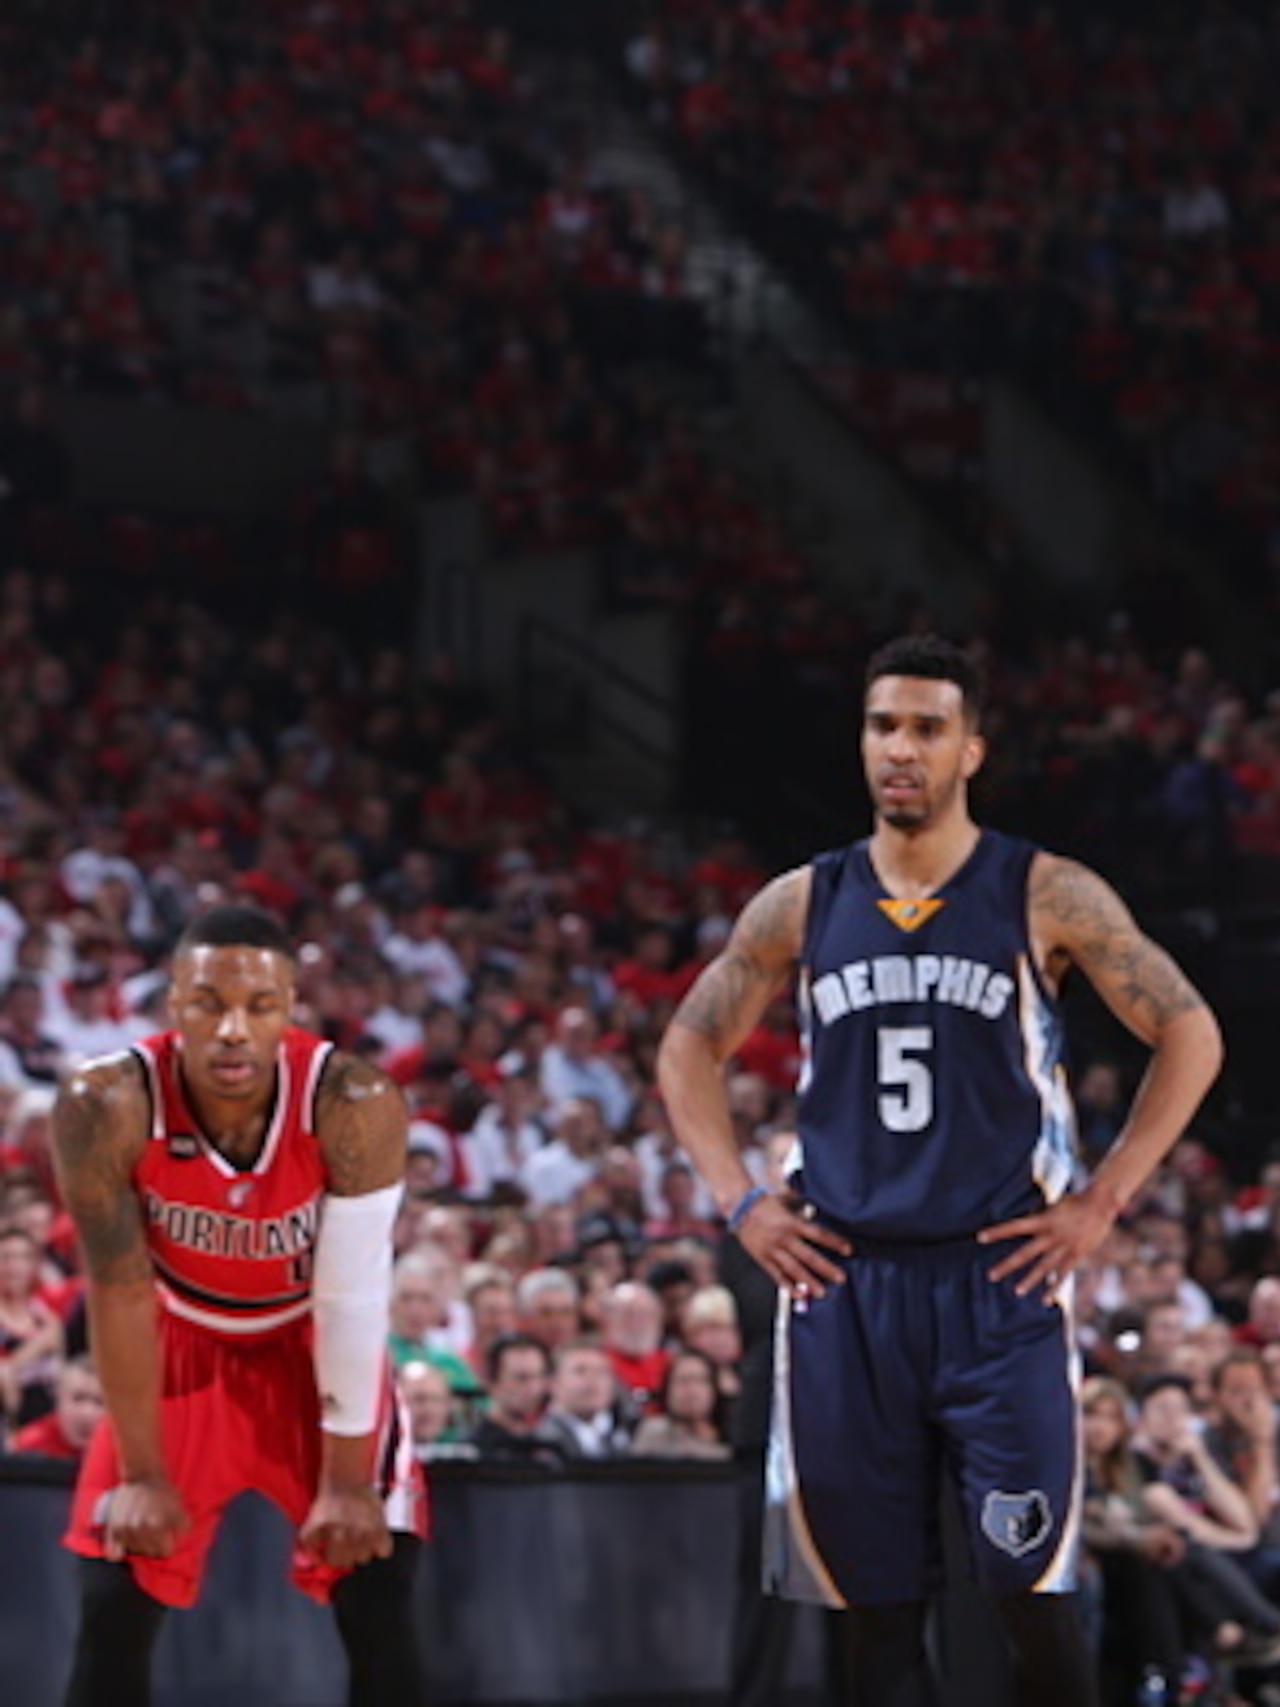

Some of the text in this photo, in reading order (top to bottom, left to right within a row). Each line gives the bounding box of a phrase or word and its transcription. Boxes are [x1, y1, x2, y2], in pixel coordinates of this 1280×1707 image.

[811, 954, 1015, 1027] MEMPHIS
[876, 1026, 934, 1133] 5
[146, 1192, 322, 1260] PORTLAN
